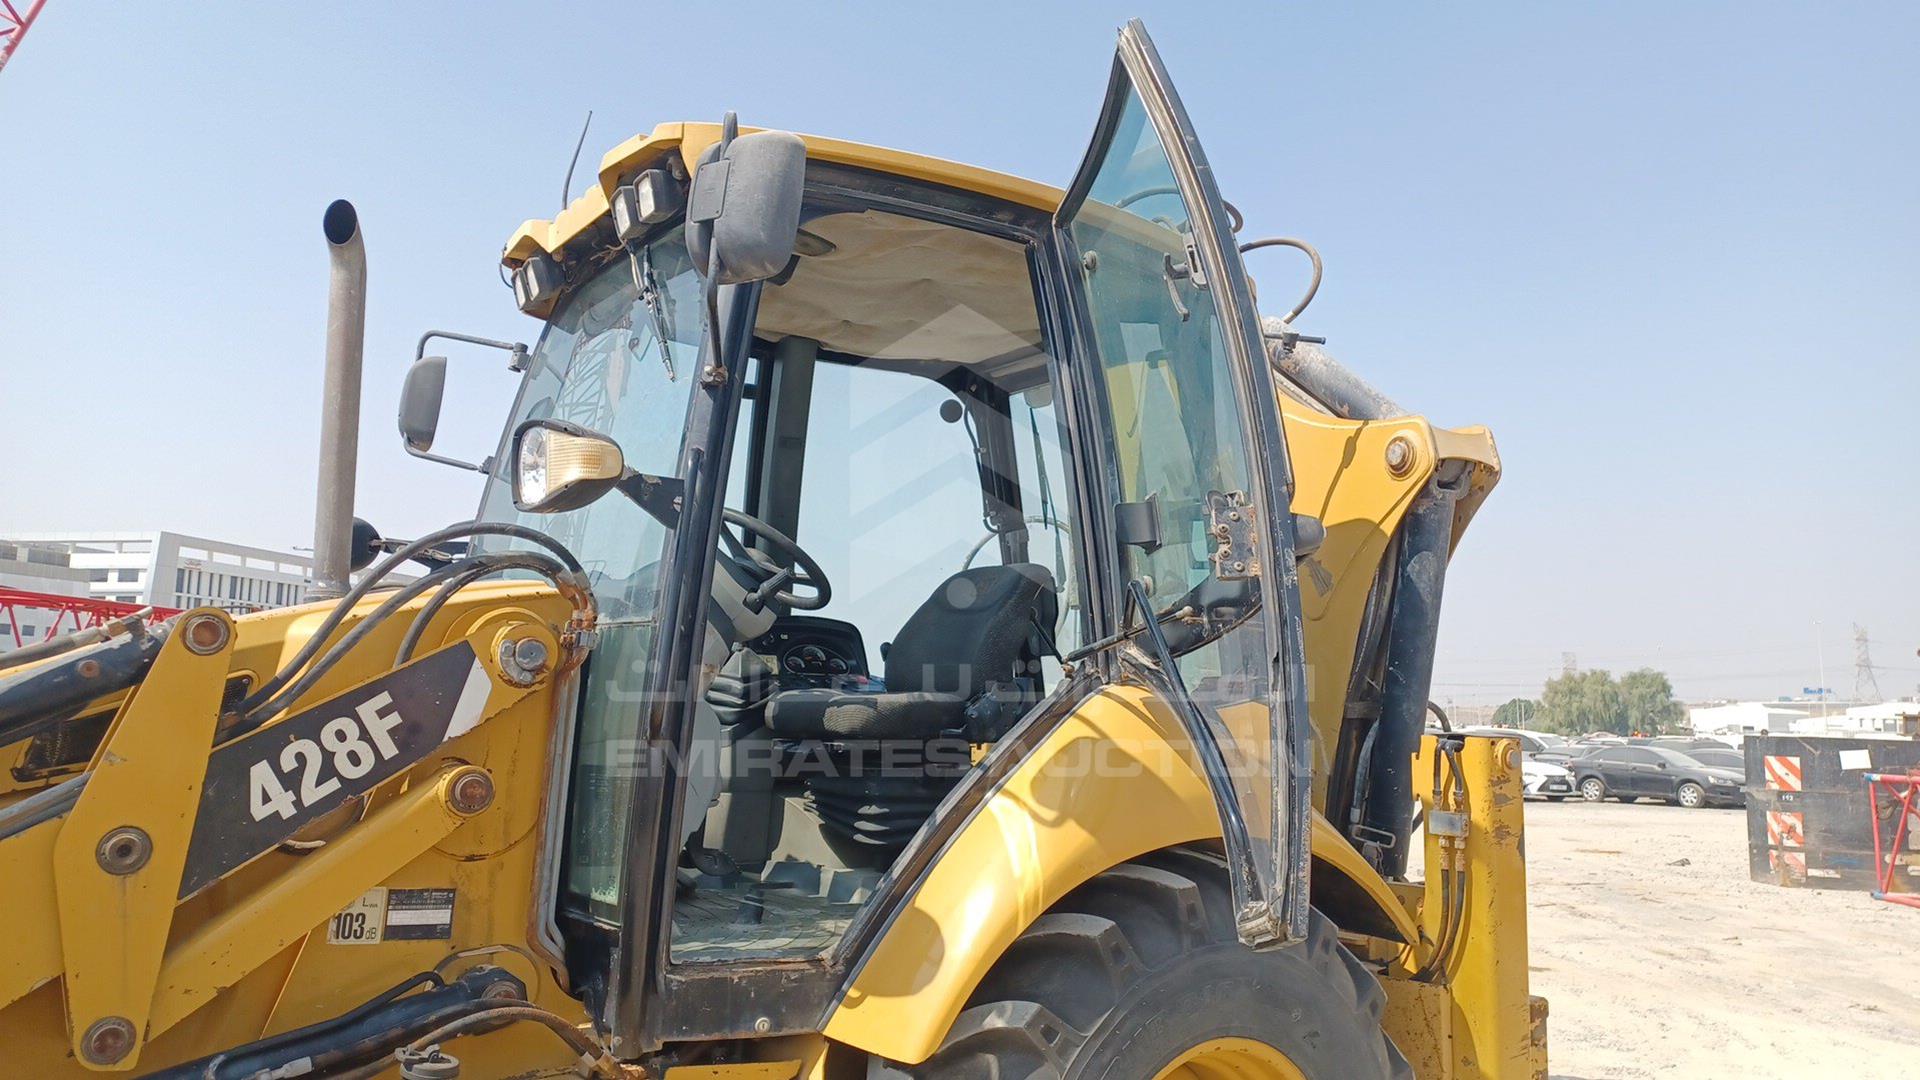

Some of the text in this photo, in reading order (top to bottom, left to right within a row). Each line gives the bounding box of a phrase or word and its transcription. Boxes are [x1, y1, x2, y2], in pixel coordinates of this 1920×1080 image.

[249, 691, 403, 822] 428F
[334, 912, 377, 940] 103 dB
